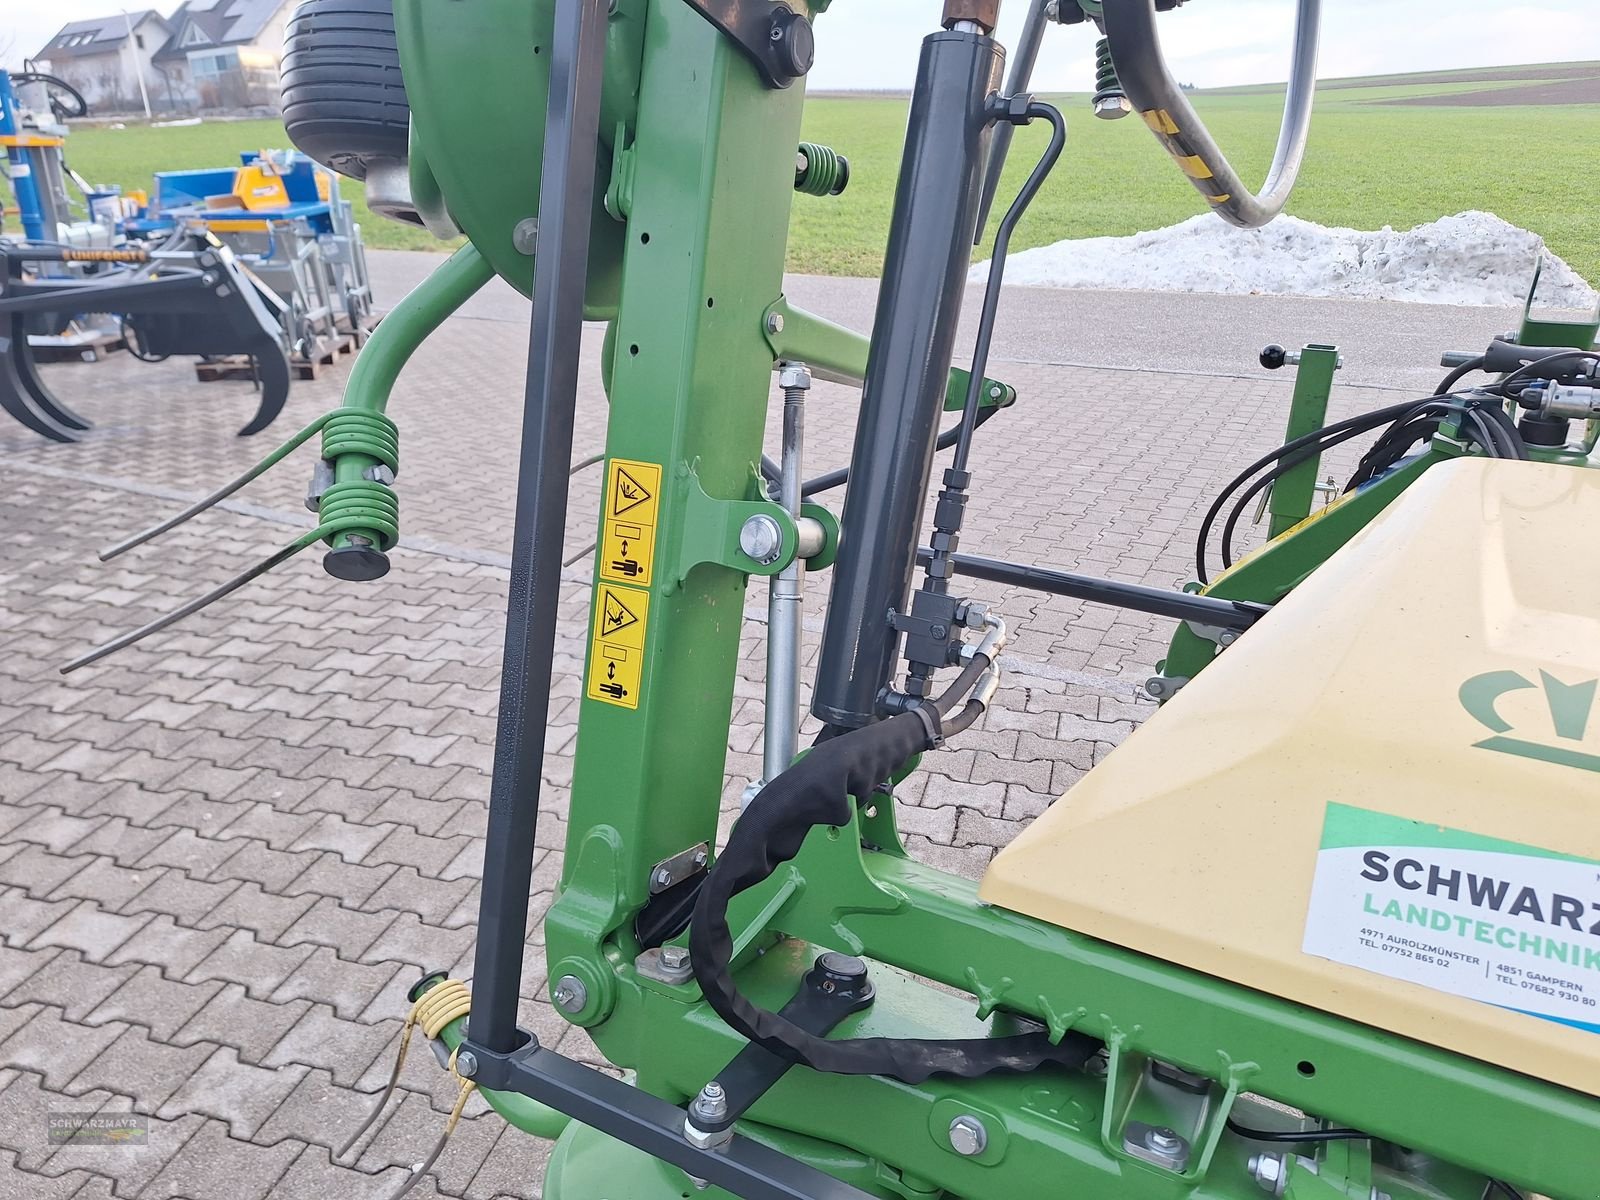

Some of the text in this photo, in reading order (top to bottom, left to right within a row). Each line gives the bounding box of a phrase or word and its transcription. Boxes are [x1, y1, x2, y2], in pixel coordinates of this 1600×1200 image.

[1360, 927, 1480, 965] 4971 AUROLZMÜNSTER
[1381, 943, 1413, 958] 07752
[1415, 952, 1434, 965] 865
[1436, 958, 1450, 968] 02
[1496, 963, 1583, 992] 4851 GAMPERN
[1521, 980, 1555, 996] 07682
[1558, 990, 1579, 1002] 930
[1582, 997, 1596, 1007] 80
